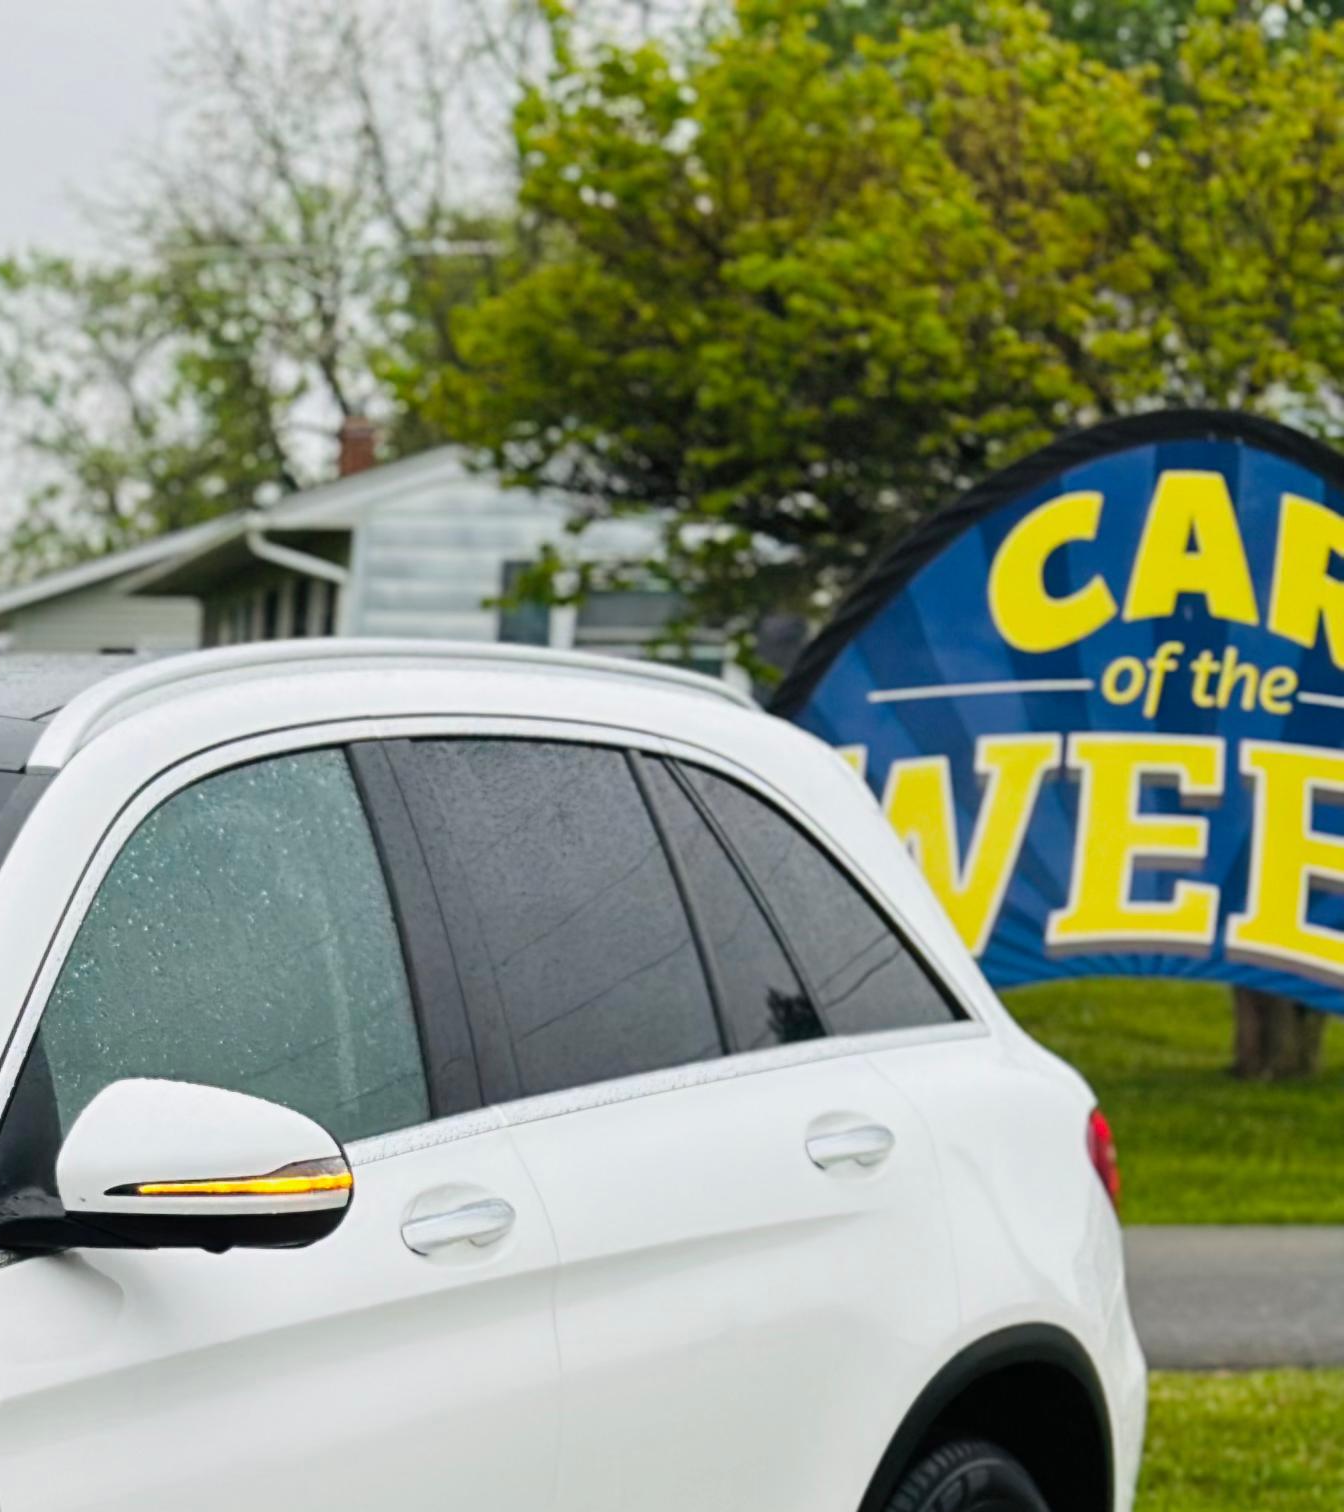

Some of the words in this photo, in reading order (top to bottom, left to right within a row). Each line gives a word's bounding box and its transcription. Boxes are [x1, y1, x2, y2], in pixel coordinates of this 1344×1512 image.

[987, 468, 1344, 673] CAR
[1100, 641, 1185, 719] of
[1191, 645, 1300, 716] the
